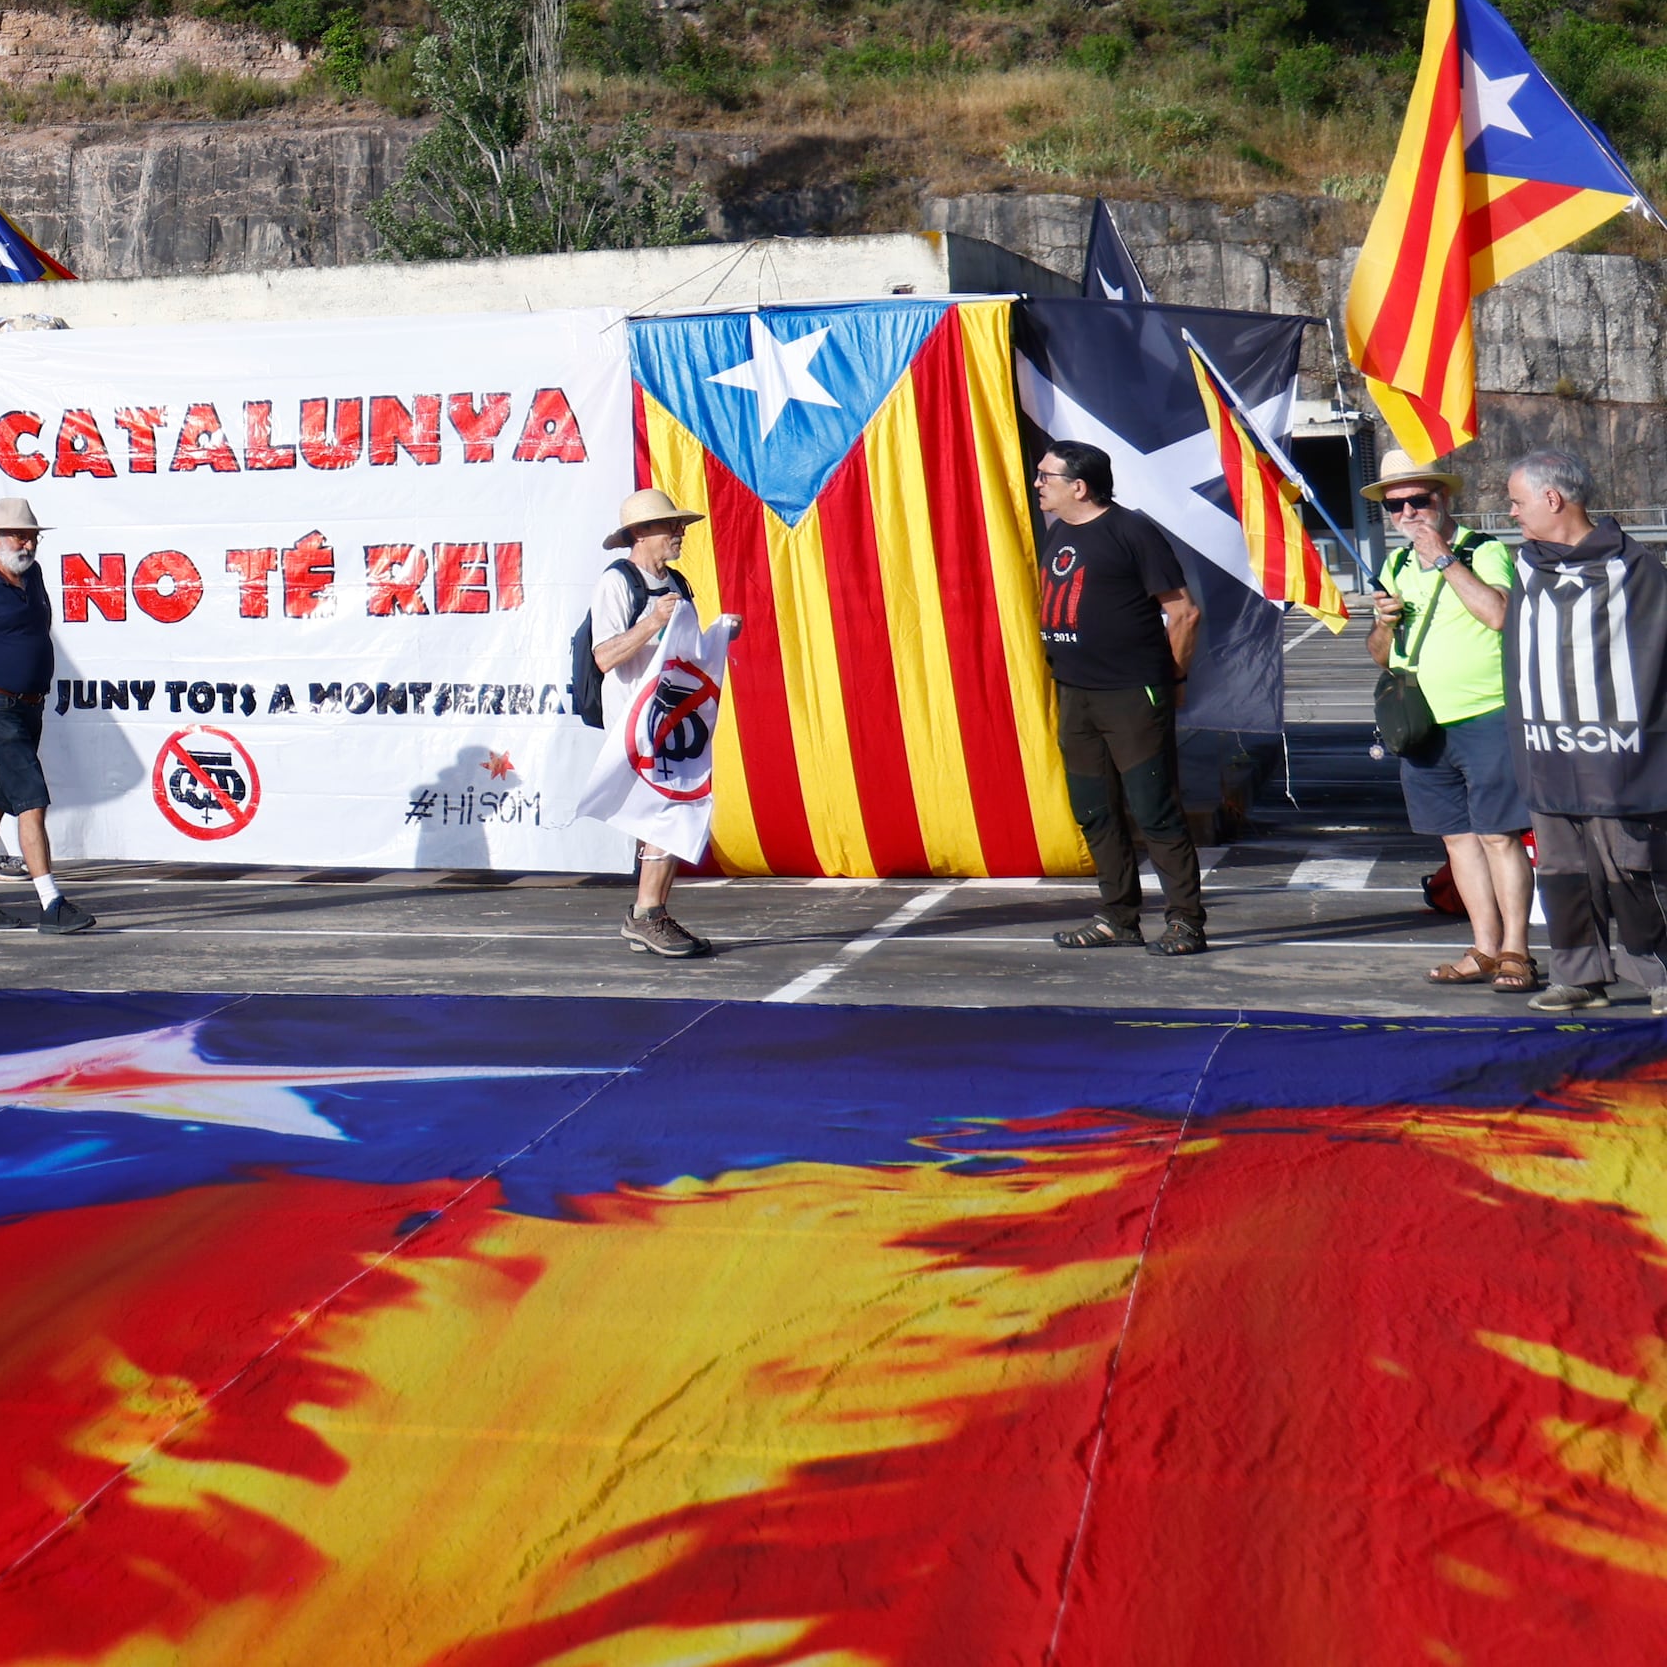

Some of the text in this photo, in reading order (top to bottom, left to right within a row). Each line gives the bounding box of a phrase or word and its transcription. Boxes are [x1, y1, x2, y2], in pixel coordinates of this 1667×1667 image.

[60, 529, 525, 623] NO TÉ REI
[1053, 632, 1077, 643] 2014
[54, 680, 156, 717] JUNY
[165, 680, 257, 717] TOTS
[267, 683, 298, 715] A
[1523, 723, 1641, 753] HI SOM
